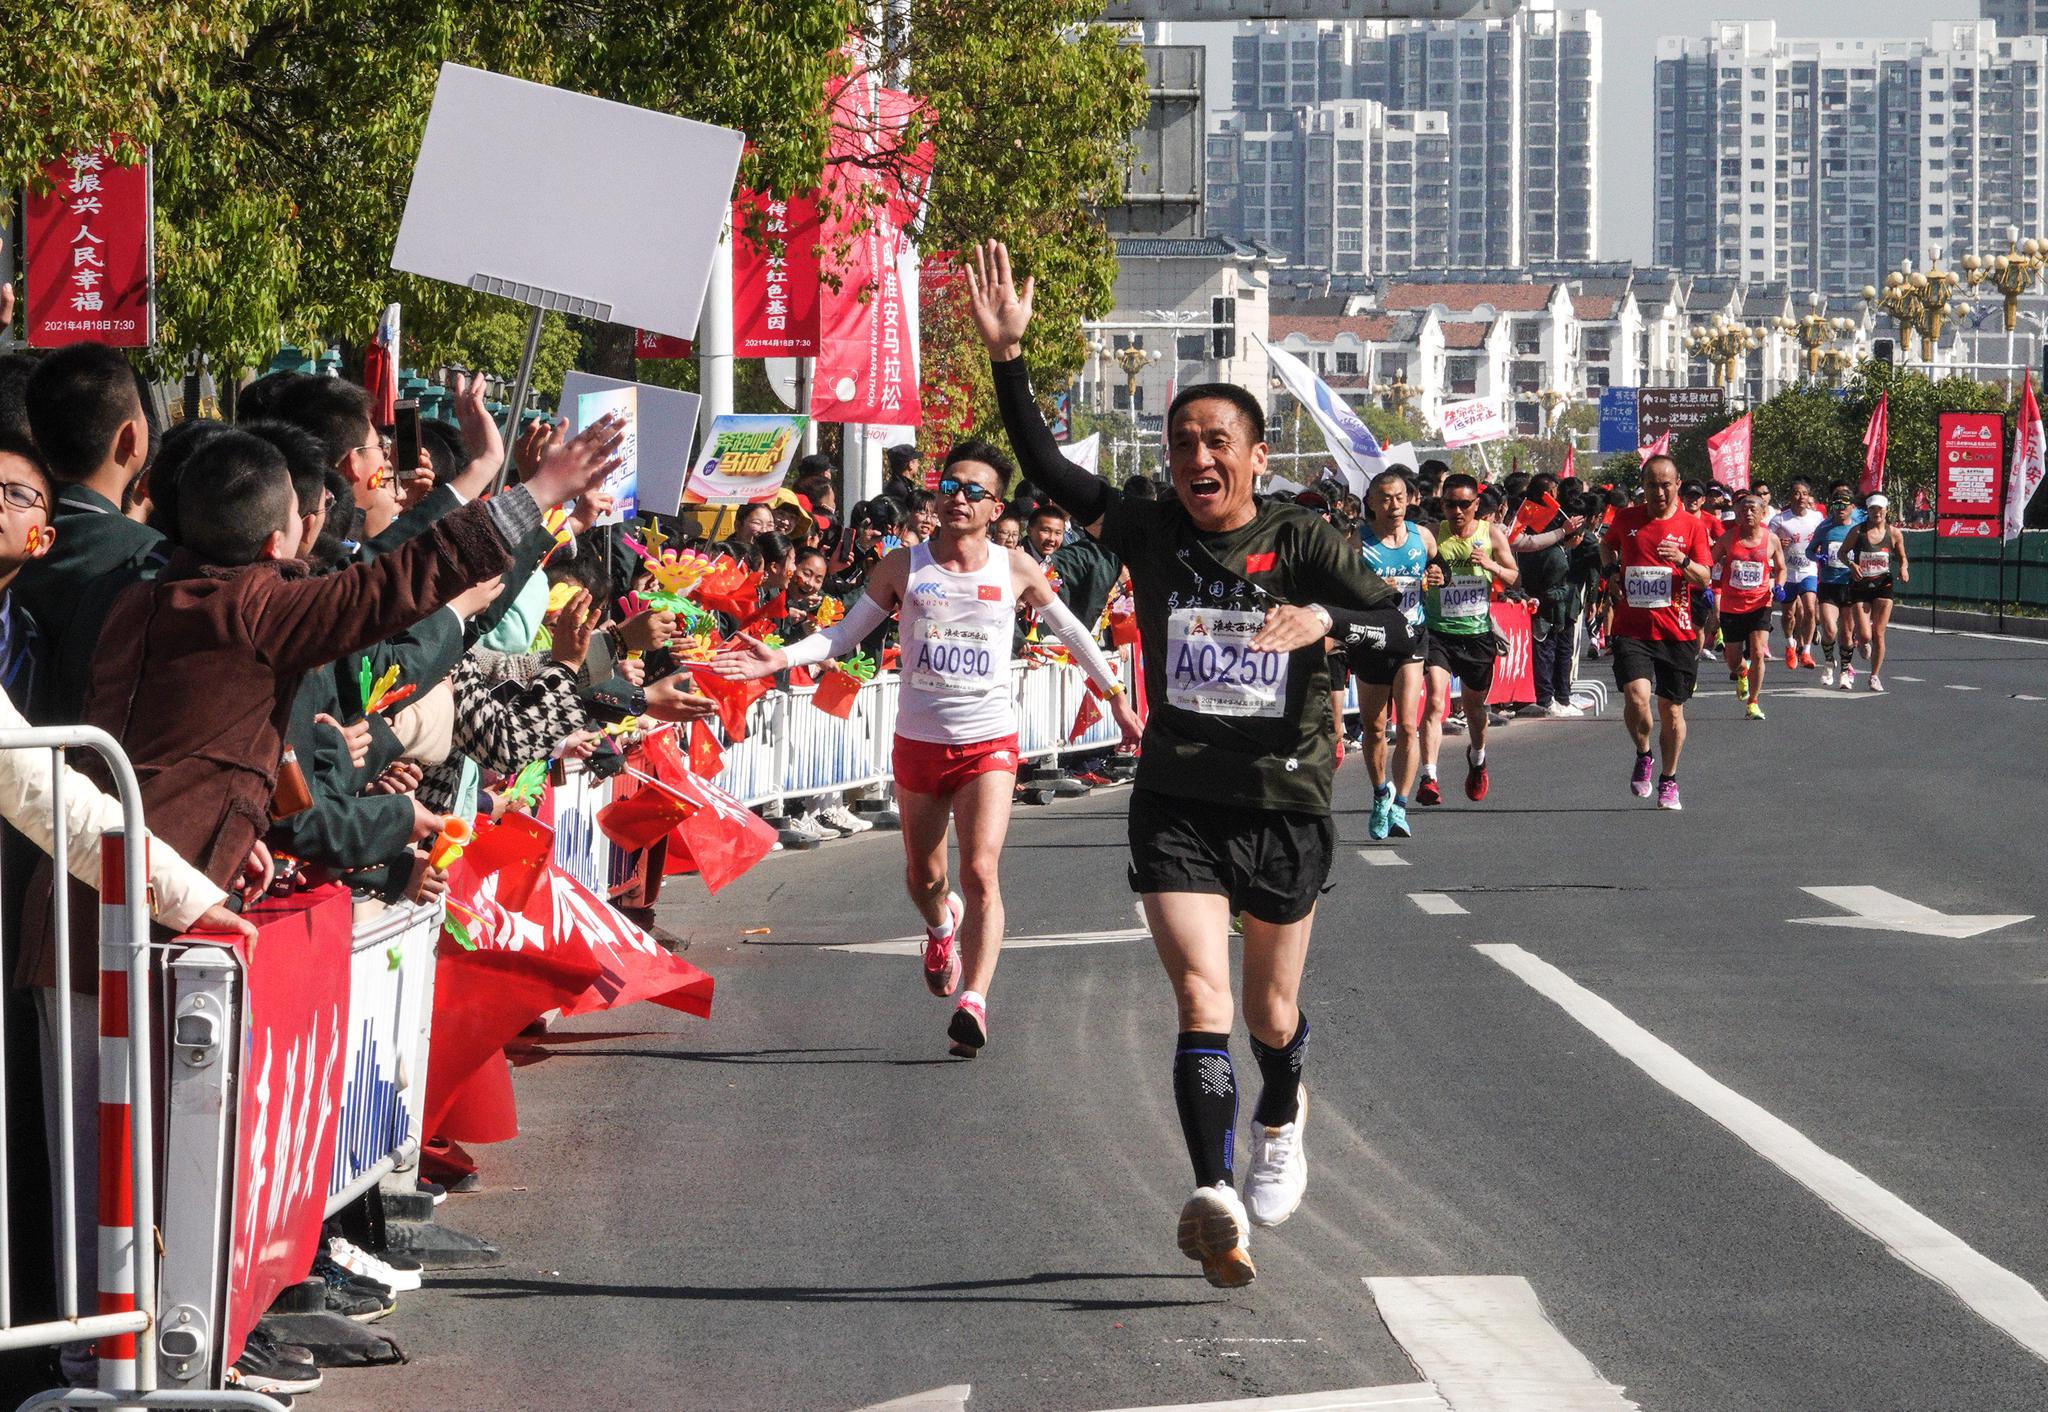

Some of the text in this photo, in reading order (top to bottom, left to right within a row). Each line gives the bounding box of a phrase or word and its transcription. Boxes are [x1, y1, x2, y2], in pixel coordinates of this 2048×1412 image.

[70, 225, 105, 312] 人民幸福
[869, 236, 880, 298] ADVENTUE
[45, 319, 135, 331] 2021年4月18日 7:30
[745, 339, 811, 348] 2021年4月18日 7:30
[867, 345, 879, 408] MARATHON
[1443, 588, 1485, 606] A0487
[1628, 580, 1667, 596] C1049
[917, 643, 990, 677] A0090
[1174, 642, 1280, 687] A0250
